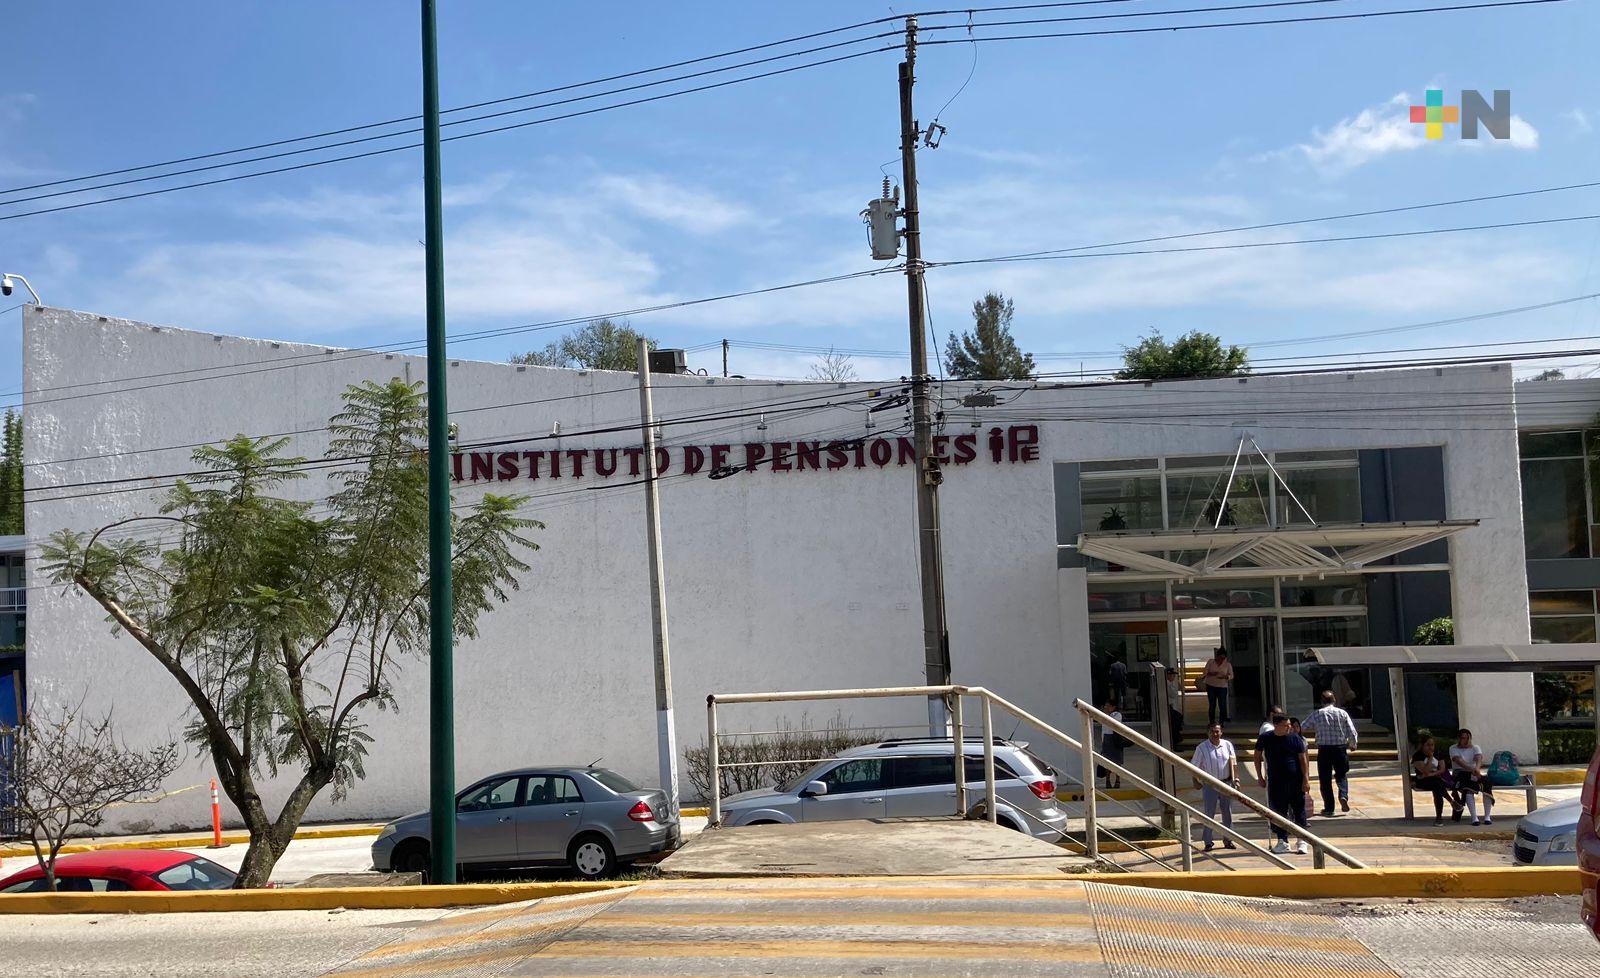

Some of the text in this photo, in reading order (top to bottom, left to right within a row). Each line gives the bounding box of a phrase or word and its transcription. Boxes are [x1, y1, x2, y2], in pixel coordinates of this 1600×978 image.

[452, 434, 977, 481] INSTITUTO DE PENSIONES
